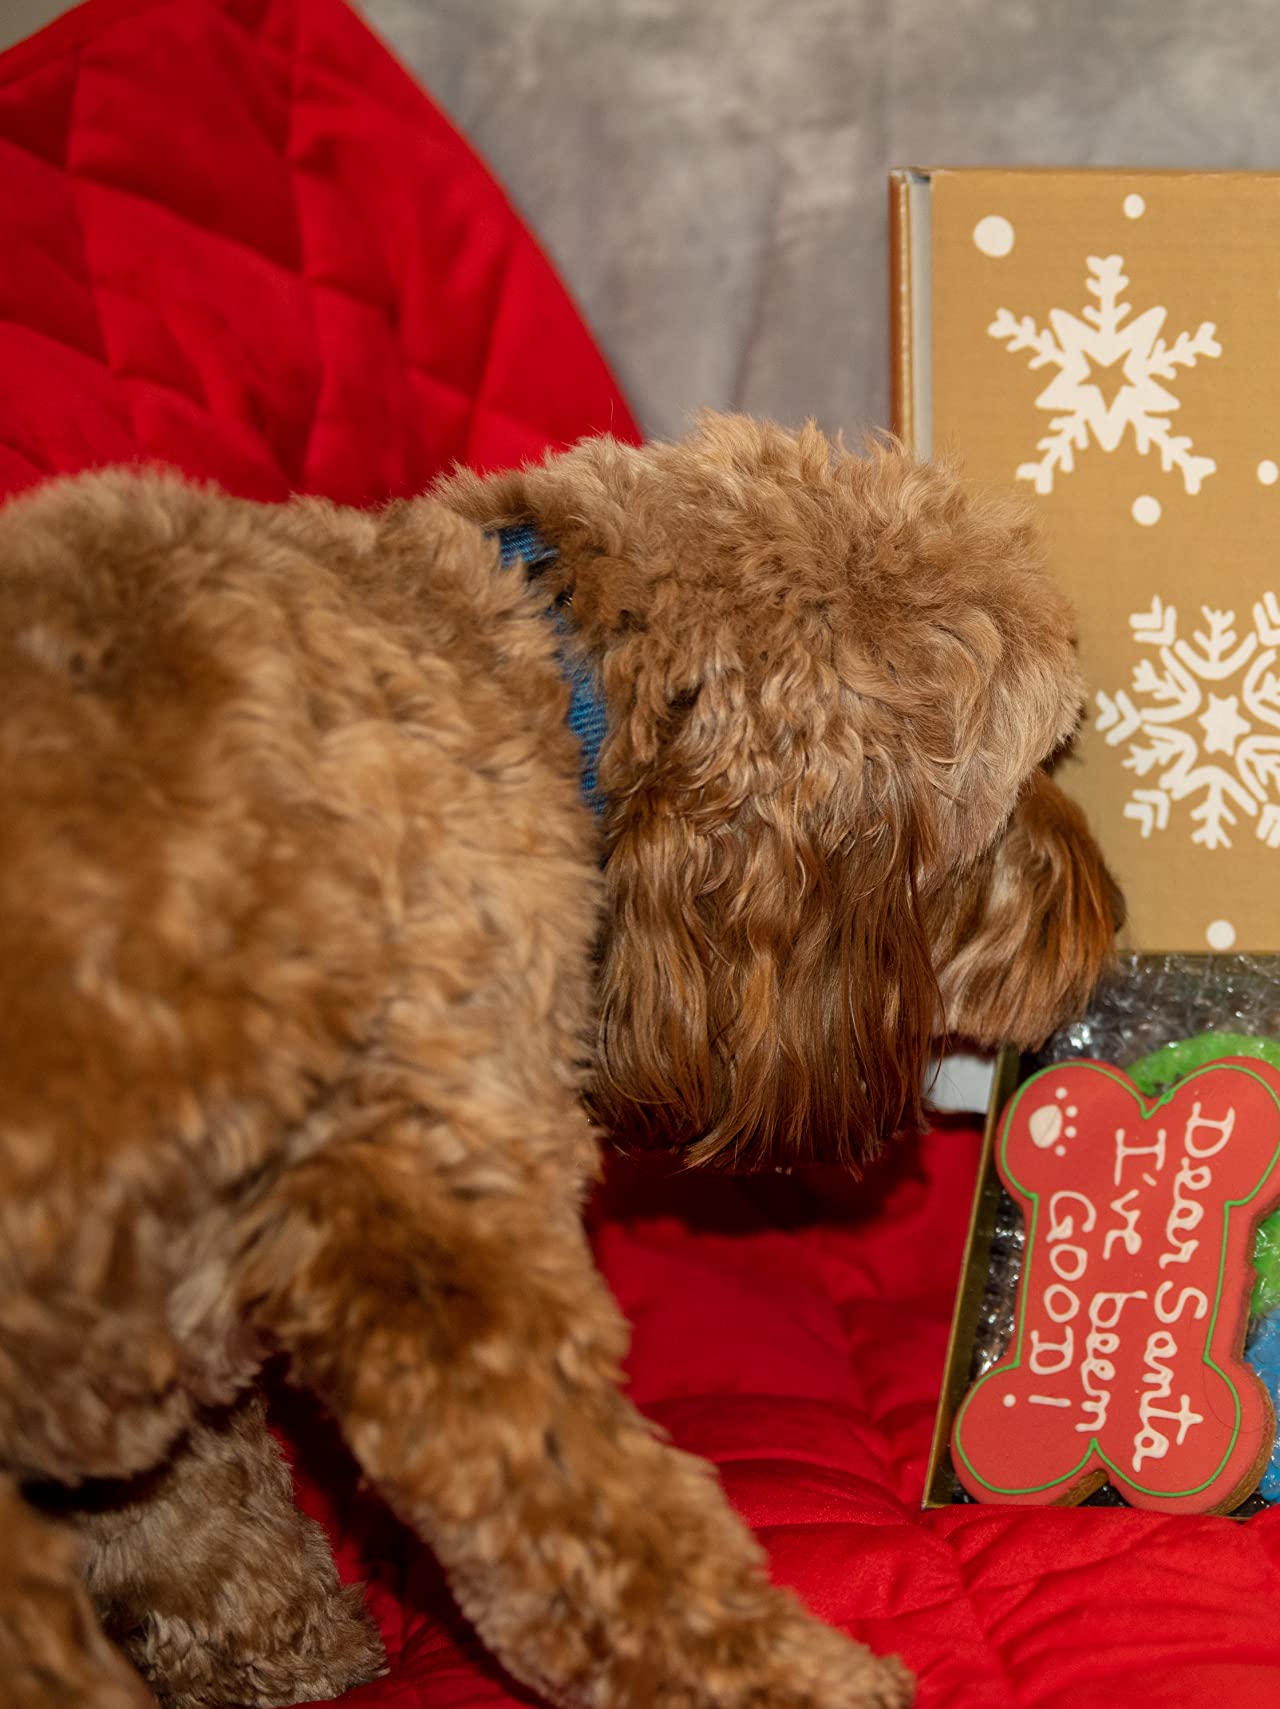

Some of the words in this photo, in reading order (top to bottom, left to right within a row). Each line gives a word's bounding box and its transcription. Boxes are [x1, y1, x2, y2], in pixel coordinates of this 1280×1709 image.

[1101, 1127, 1167, 1261] I've
[1157, 1101, 1236, 1270] Dear
[1074, 1289, 1149, 1433] been
[1131, 1280, 1209, 1474] Santa
